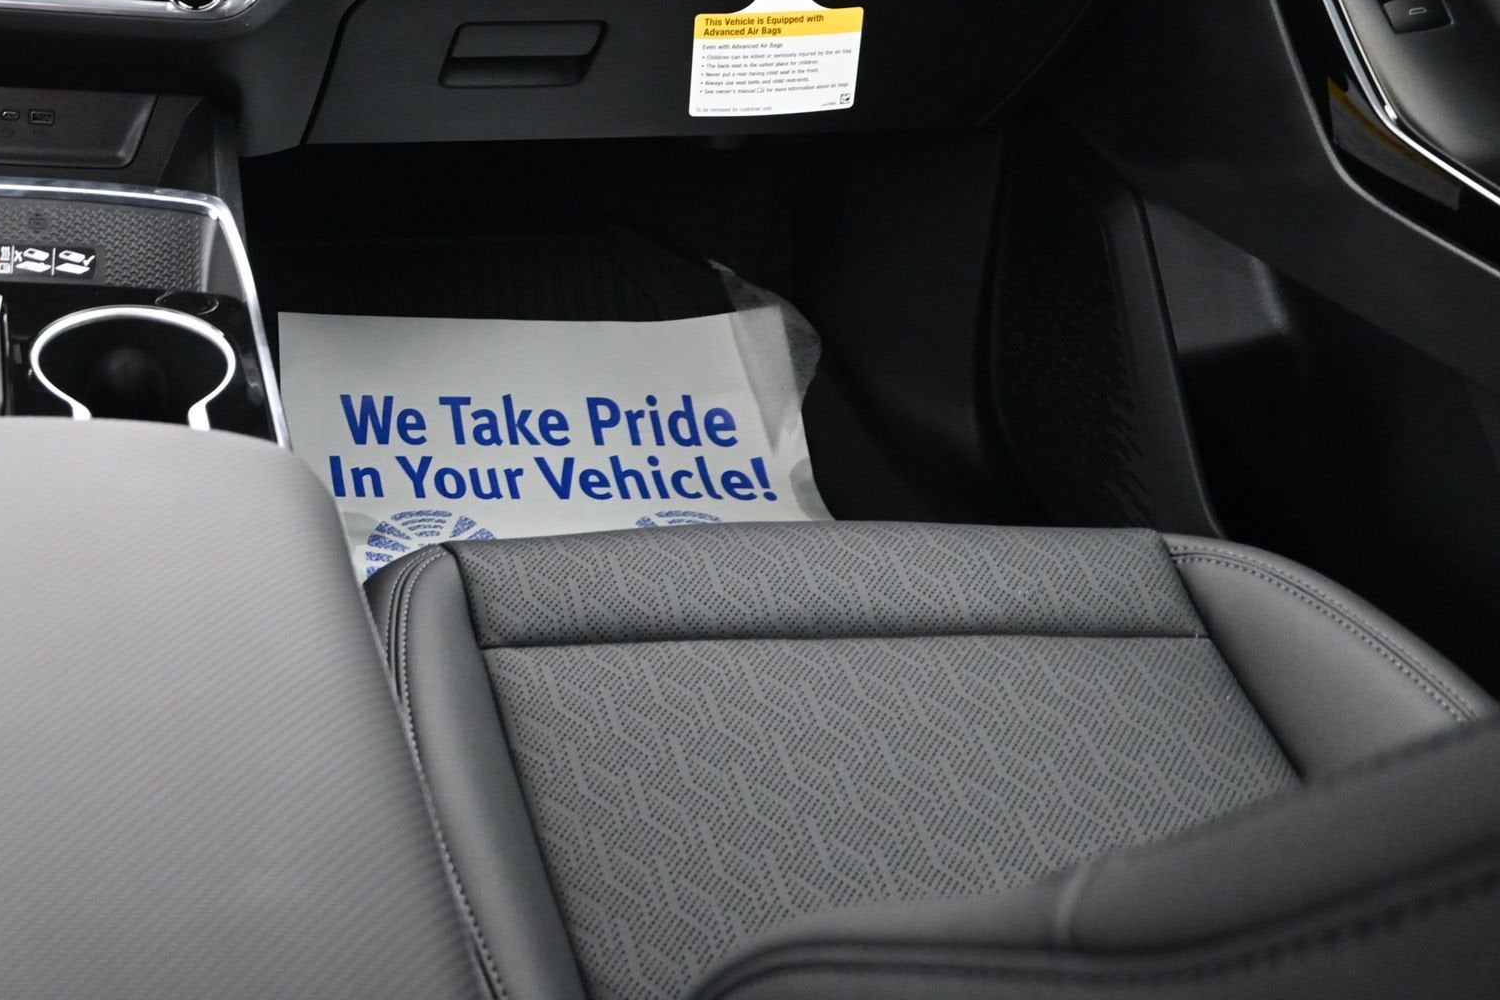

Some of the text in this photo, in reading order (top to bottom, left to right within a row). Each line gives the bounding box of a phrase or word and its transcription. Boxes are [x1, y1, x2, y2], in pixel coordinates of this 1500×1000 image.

[703, 26, 782, 37] Advanced Air Bags
[705, 14, 824, 26] This Vehicle is Equipped with
[340, 394, 740, 449] We Take Pride
[328, 454, 779, 502] In Your Vehicle!
